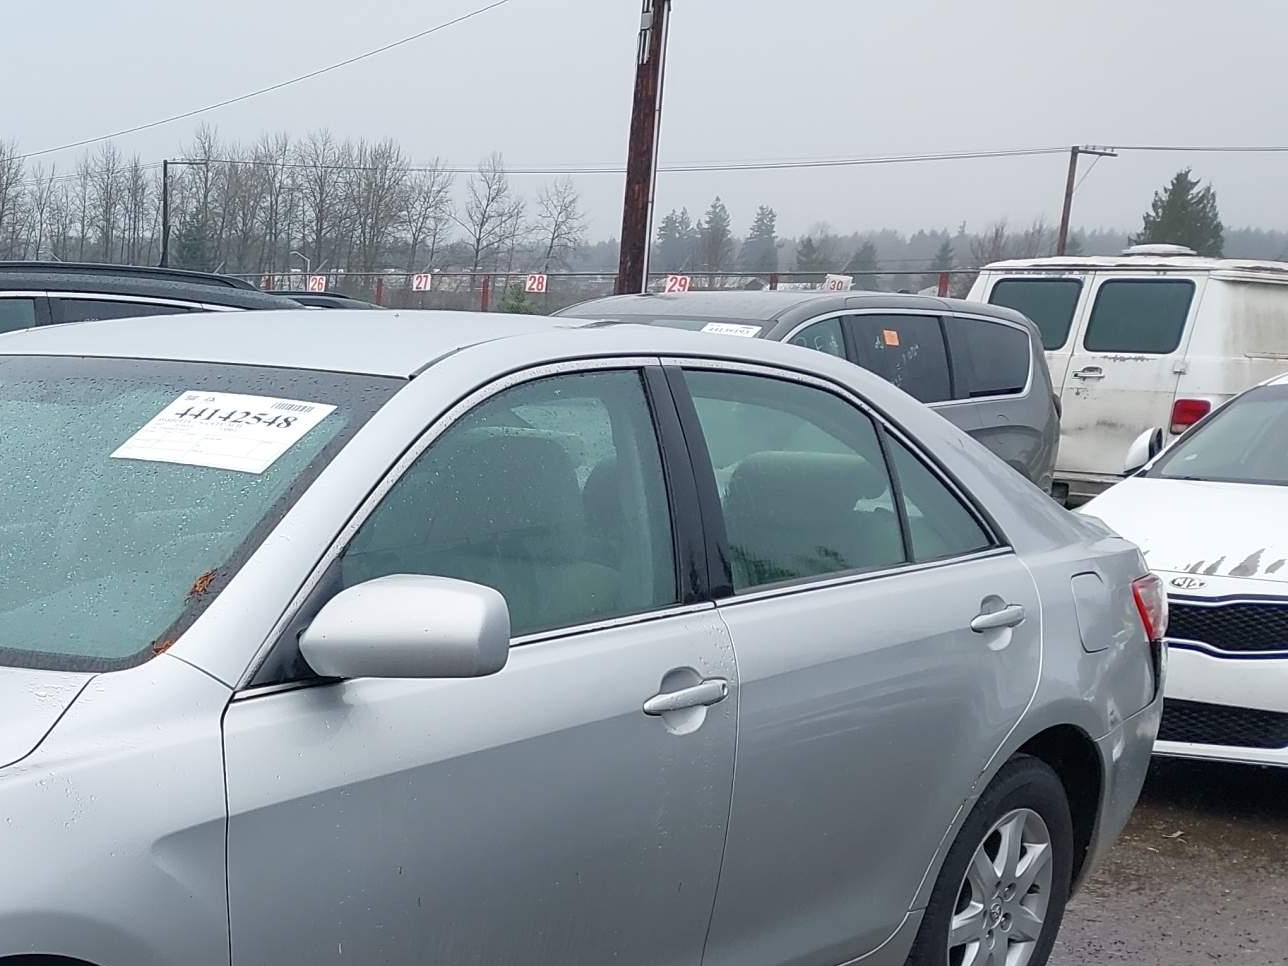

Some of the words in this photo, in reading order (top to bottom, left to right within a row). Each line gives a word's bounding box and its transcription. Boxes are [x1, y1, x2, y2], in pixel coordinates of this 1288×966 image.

[310, 277, 325, 291] 26
[415, 275, 429, 290] 27
[527, 275, 545, 291] 28
[667, 276, 688, 293] 29
[829, 279, 844, 291] 30
[175, 406, 298, 429] 44142548
